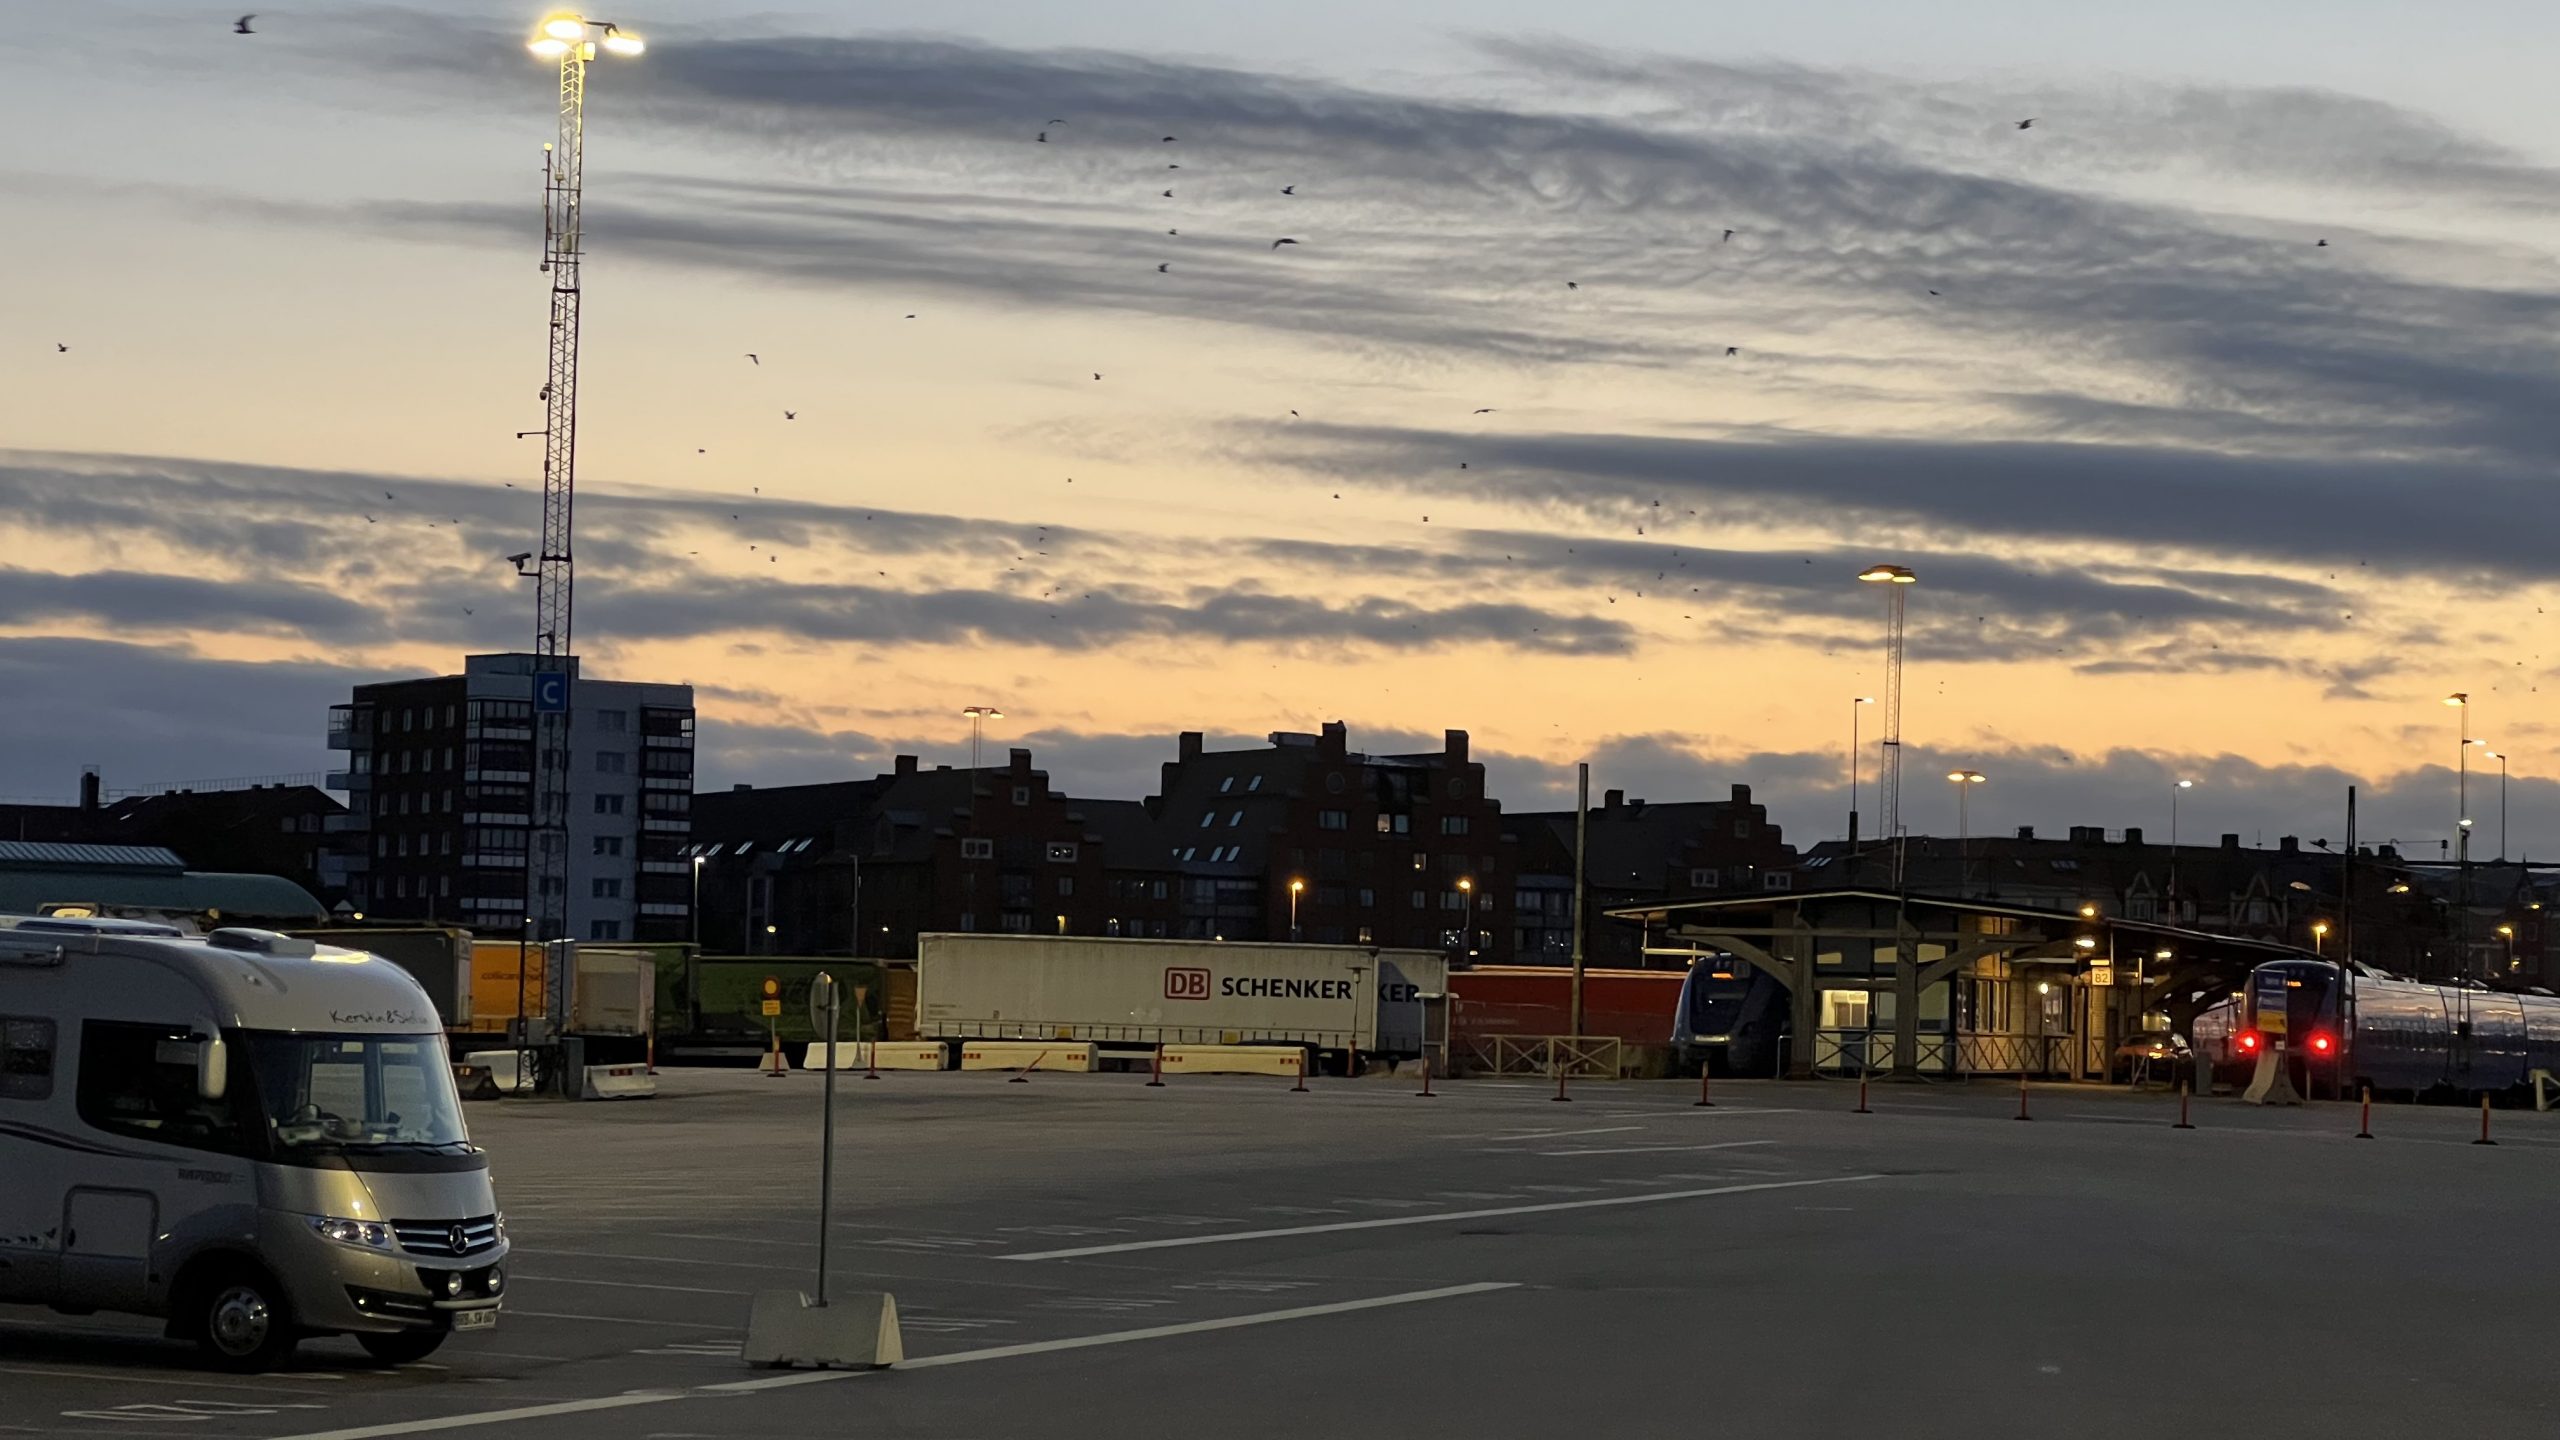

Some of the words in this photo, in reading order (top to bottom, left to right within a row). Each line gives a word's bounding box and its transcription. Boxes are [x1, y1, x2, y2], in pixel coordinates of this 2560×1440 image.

[543, 681, 559, 704] C
[1169, 972, 1206, 995] DB
[1221, 977, 1353, 1000] SCHENKER
